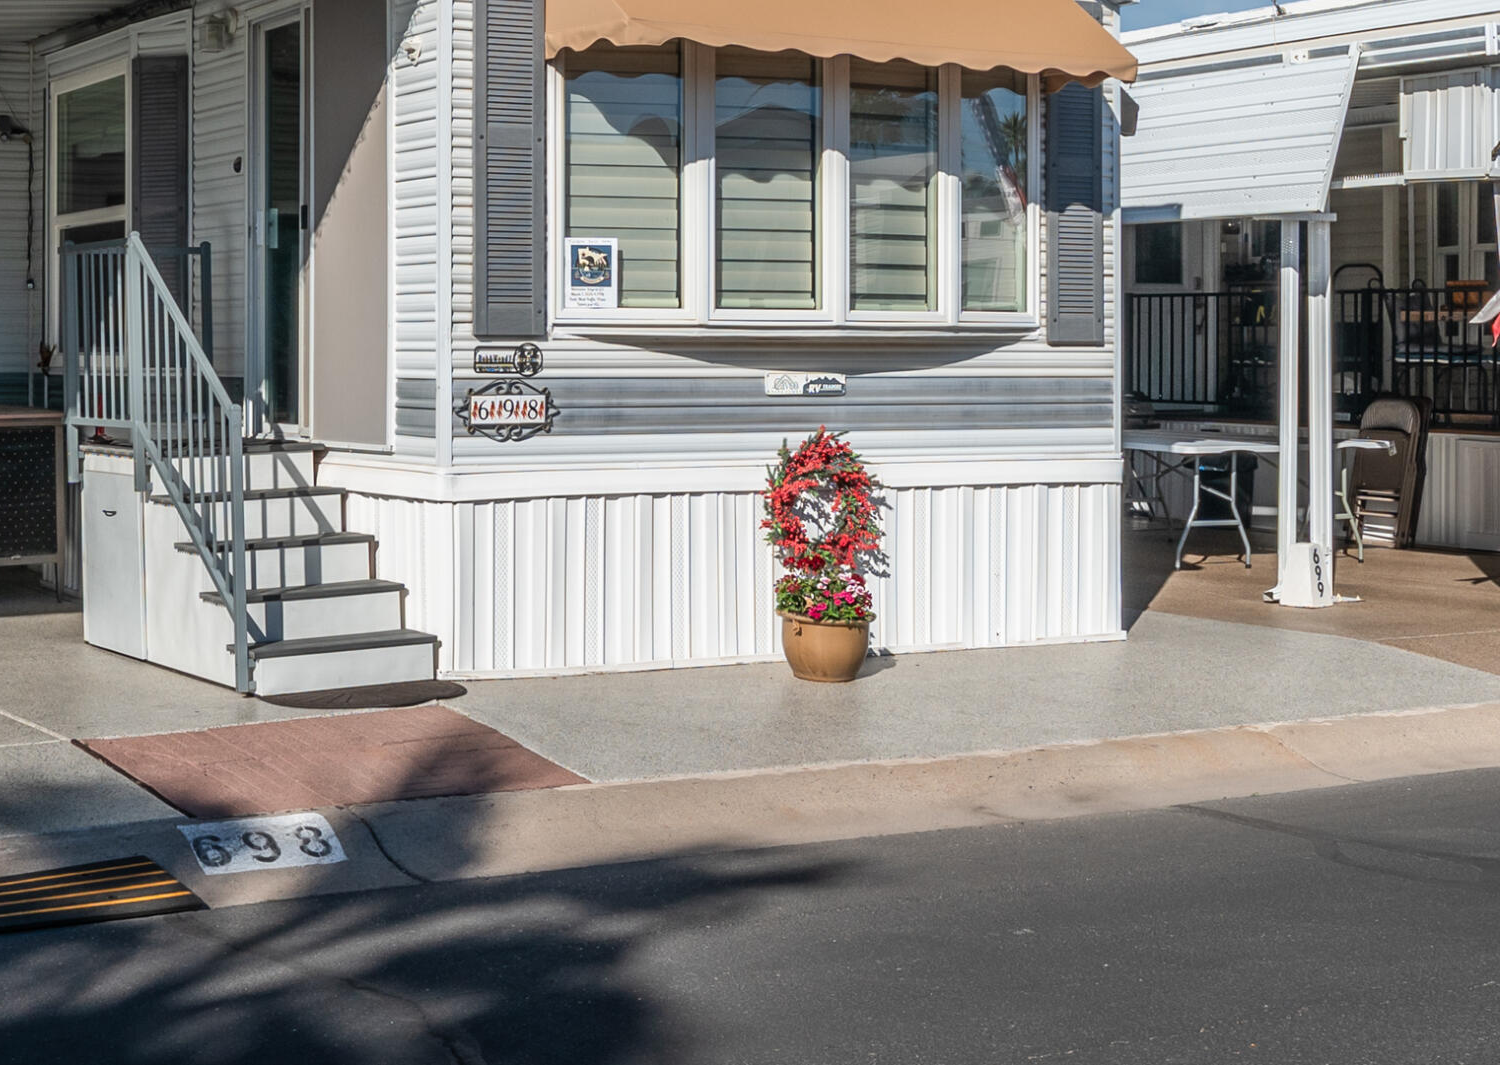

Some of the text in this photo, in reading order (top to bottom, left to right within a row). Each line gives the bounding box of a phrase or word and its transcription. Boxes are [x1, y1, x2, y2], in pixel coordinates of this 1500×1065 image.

[808, 383, 822, 393] RV
[478, 399, 539, 420] 698
[1313, 548, 1325, 598] 699
[192, 825, 333, 867] 698
